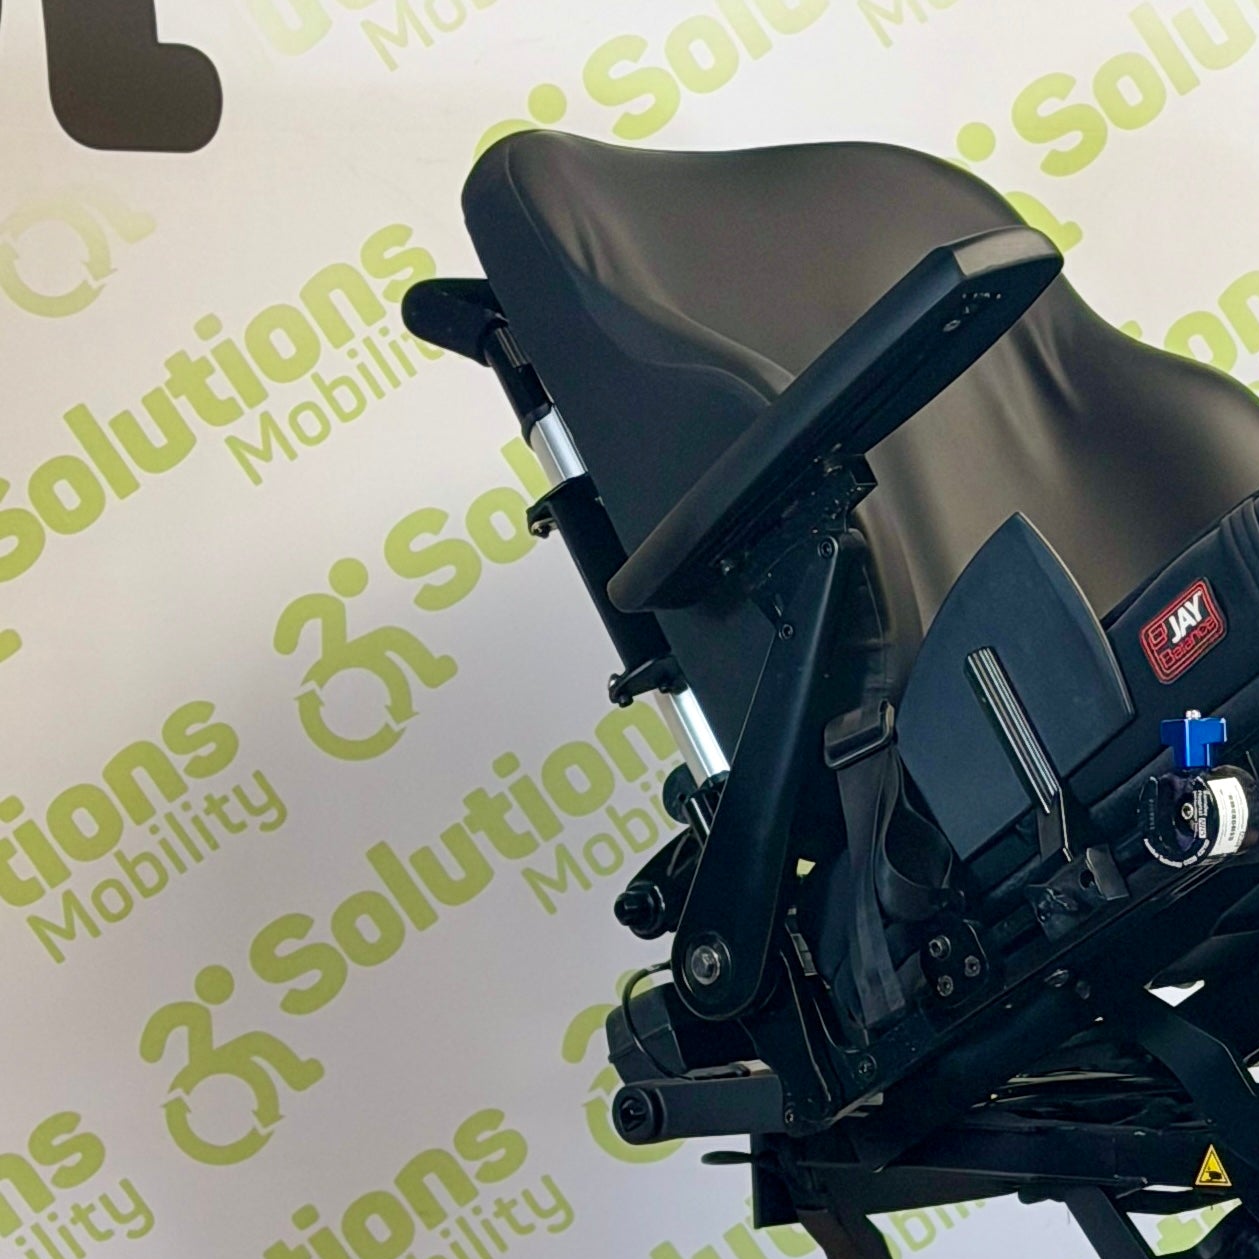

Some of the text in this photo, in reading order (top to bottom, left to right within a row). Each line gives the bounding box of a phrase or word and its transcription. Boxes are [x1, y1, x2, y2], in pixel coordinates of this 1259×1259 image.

[1160, 616, 1217, 669] Balance
[1168, 590, 1203, 644] JAY
[27, 769, 288, 964] Mobility
[249, 698, 680, 1015] Solution
